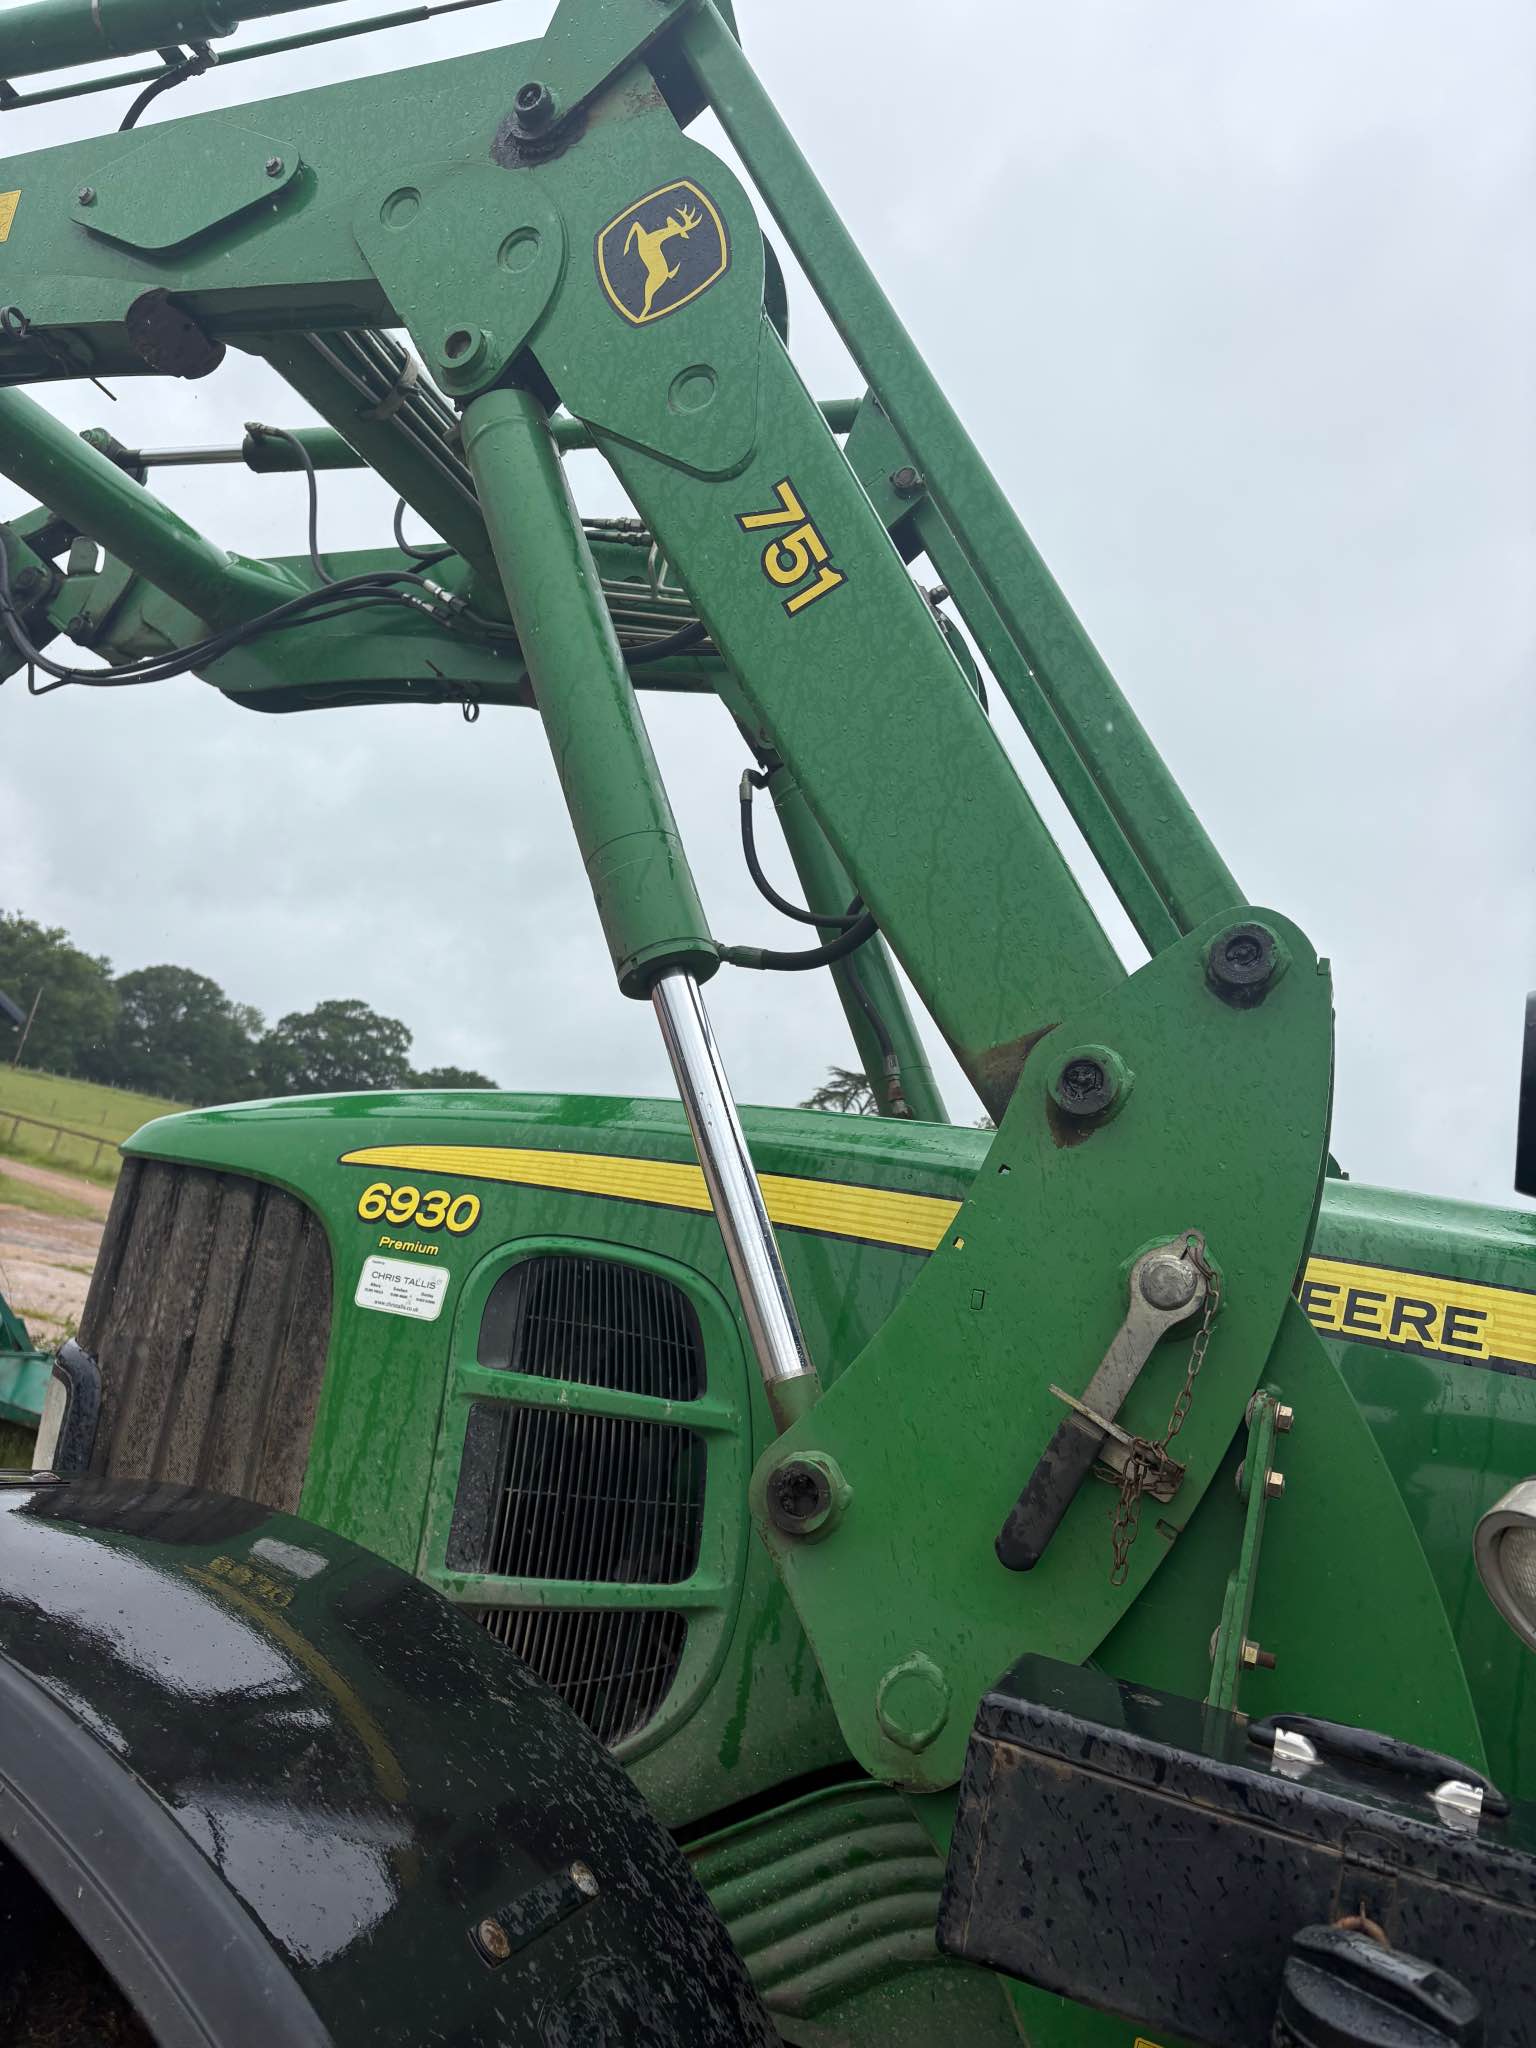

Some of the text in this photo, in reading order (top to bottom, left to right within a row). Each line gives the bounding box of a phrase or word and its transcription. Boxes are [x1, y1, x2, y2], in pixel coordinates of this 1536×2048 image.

[735, 476, 849, 618] 751
[357, 1181, 482, 1236] 6930
[378, 1235, 439, 1256] Premium
[371, 1270, 437, 1290] CHRIS TALLIS
[1300, 1279, 1489, 1354] EERE
